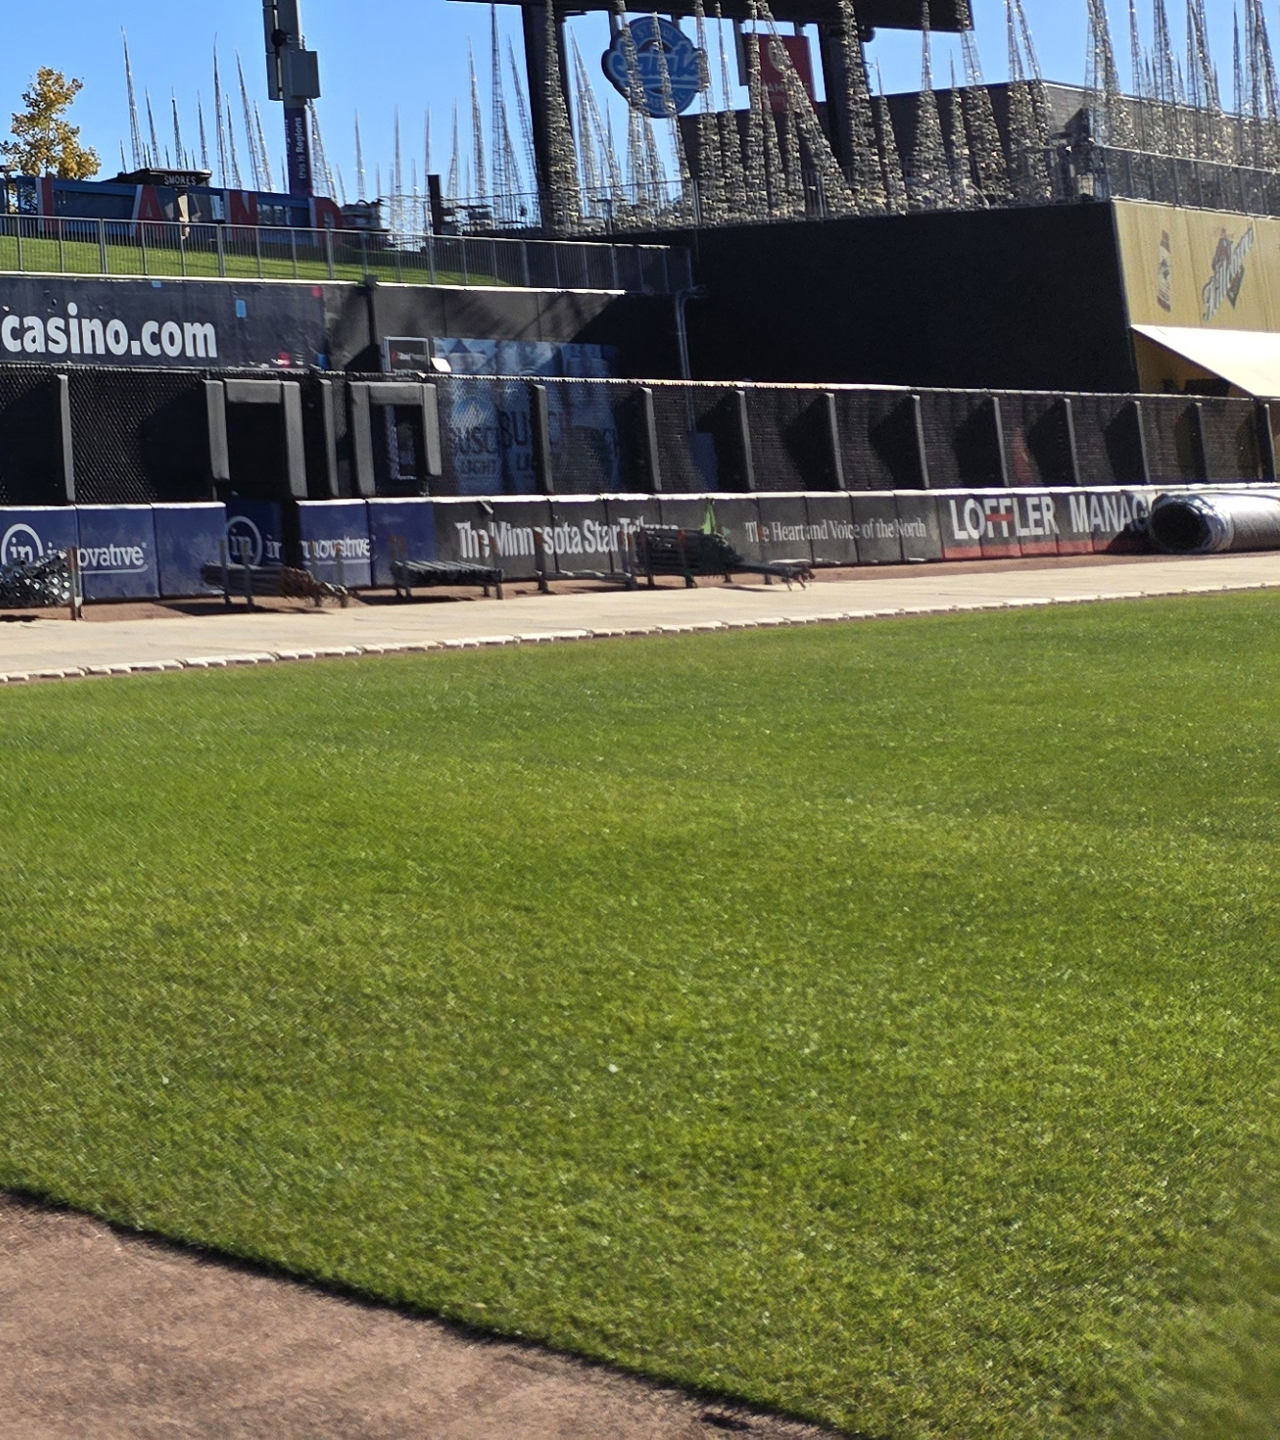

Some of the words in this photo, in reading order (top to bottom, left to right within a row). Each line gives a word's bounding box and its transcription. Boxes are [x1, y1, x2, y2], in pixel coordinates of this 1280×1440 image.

[294, 116, 306, 153] Regions
[163, 174, 197, 186] SMORES
[771, 521, 806, 542] Heart
[805, 519, 828, 541] and
[828, 519, 861, 540] Voice
[862, 517, 877, 540] of
[876, 517, 896, 539] the
[895, 516, 927, 538] North
[948, 495, 1060, 540] LOFFLER
[1068, 494, 1150, 533] MANAG
[454, 520, 490, 559] The
[489, 520, 584, 557] Minnsota
[582, 518, 621, 554] Star
